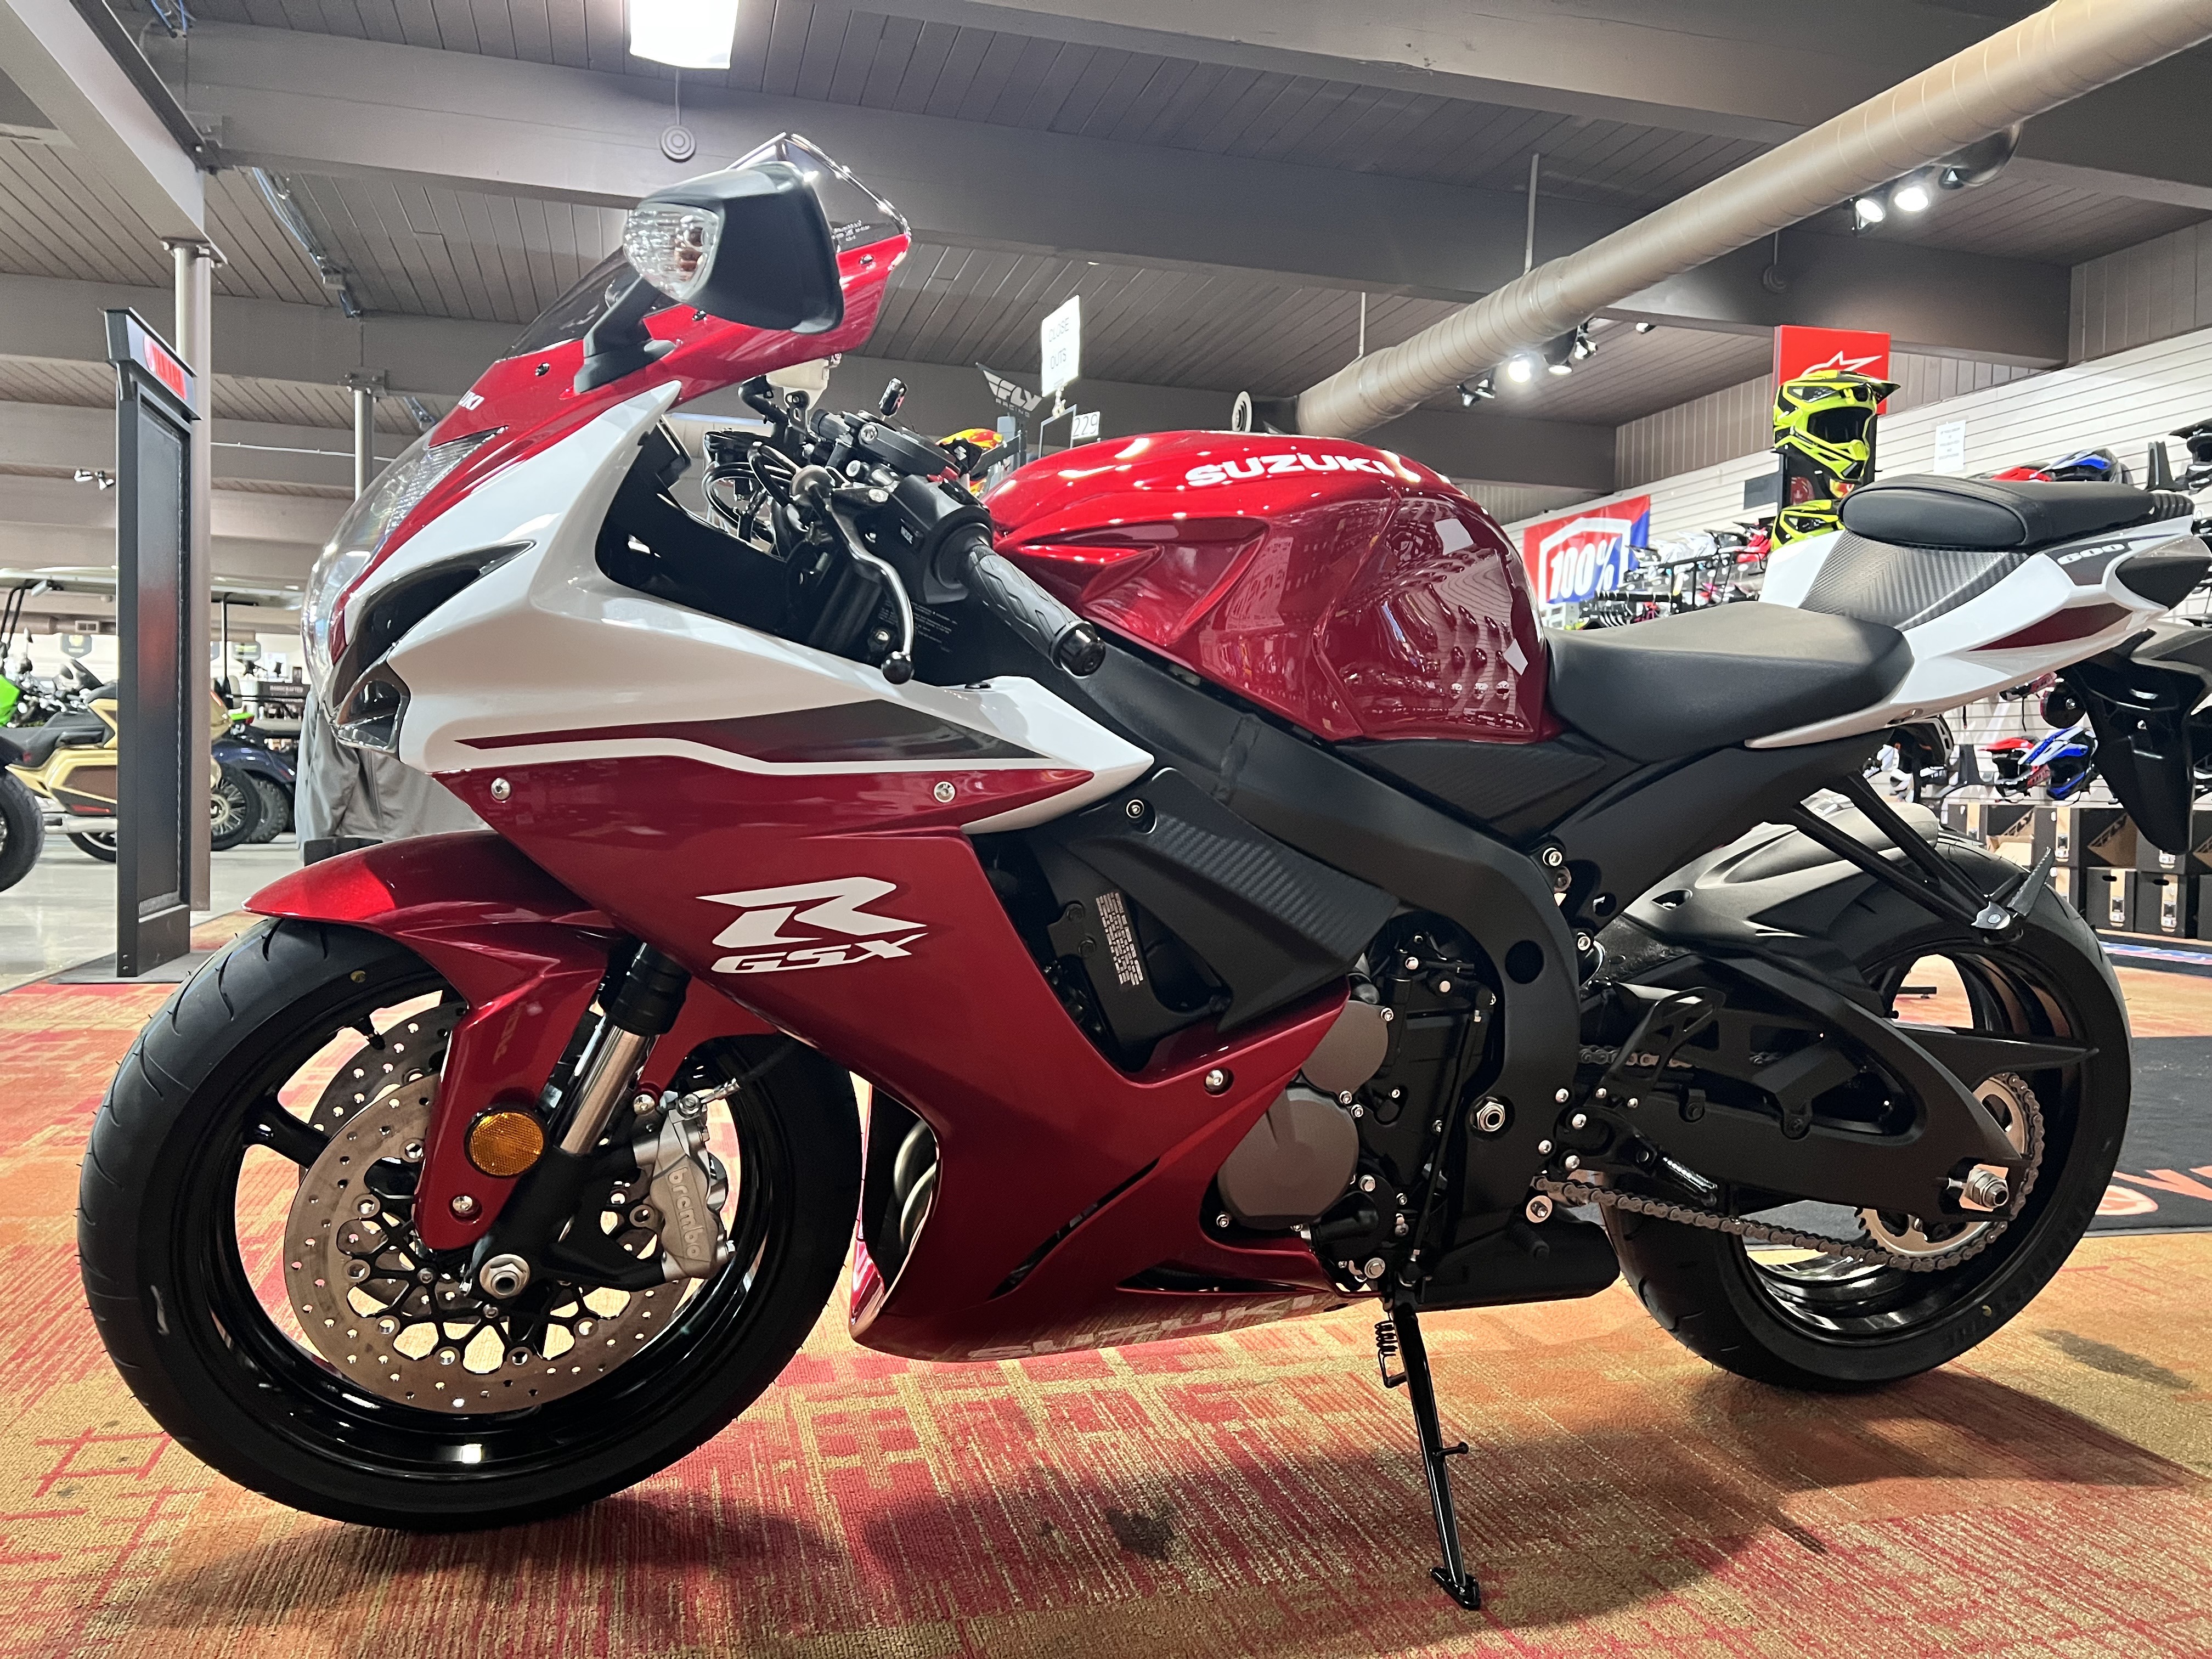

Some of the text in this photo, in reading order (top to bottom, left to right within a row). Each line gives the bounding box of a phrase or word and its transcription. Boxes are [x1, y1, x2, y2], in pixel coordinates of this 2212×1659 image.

[1049, 317, 1069, 342] CLOSE
[1050, 348, 1066, 369] OUTS
[993, 377, 1042, 411] FLY
[1073, 413, 1098, 437] 229
[1185, 454, 1396, 487] SUZUKI
[1549, 537, 1617, 600] 100%
[2057, 543, 2125, 565] 600
[696, 876, 928, 949] R
[710, 932, 929, 974] GSX
[668, 1166, 704, 1259] brembo
